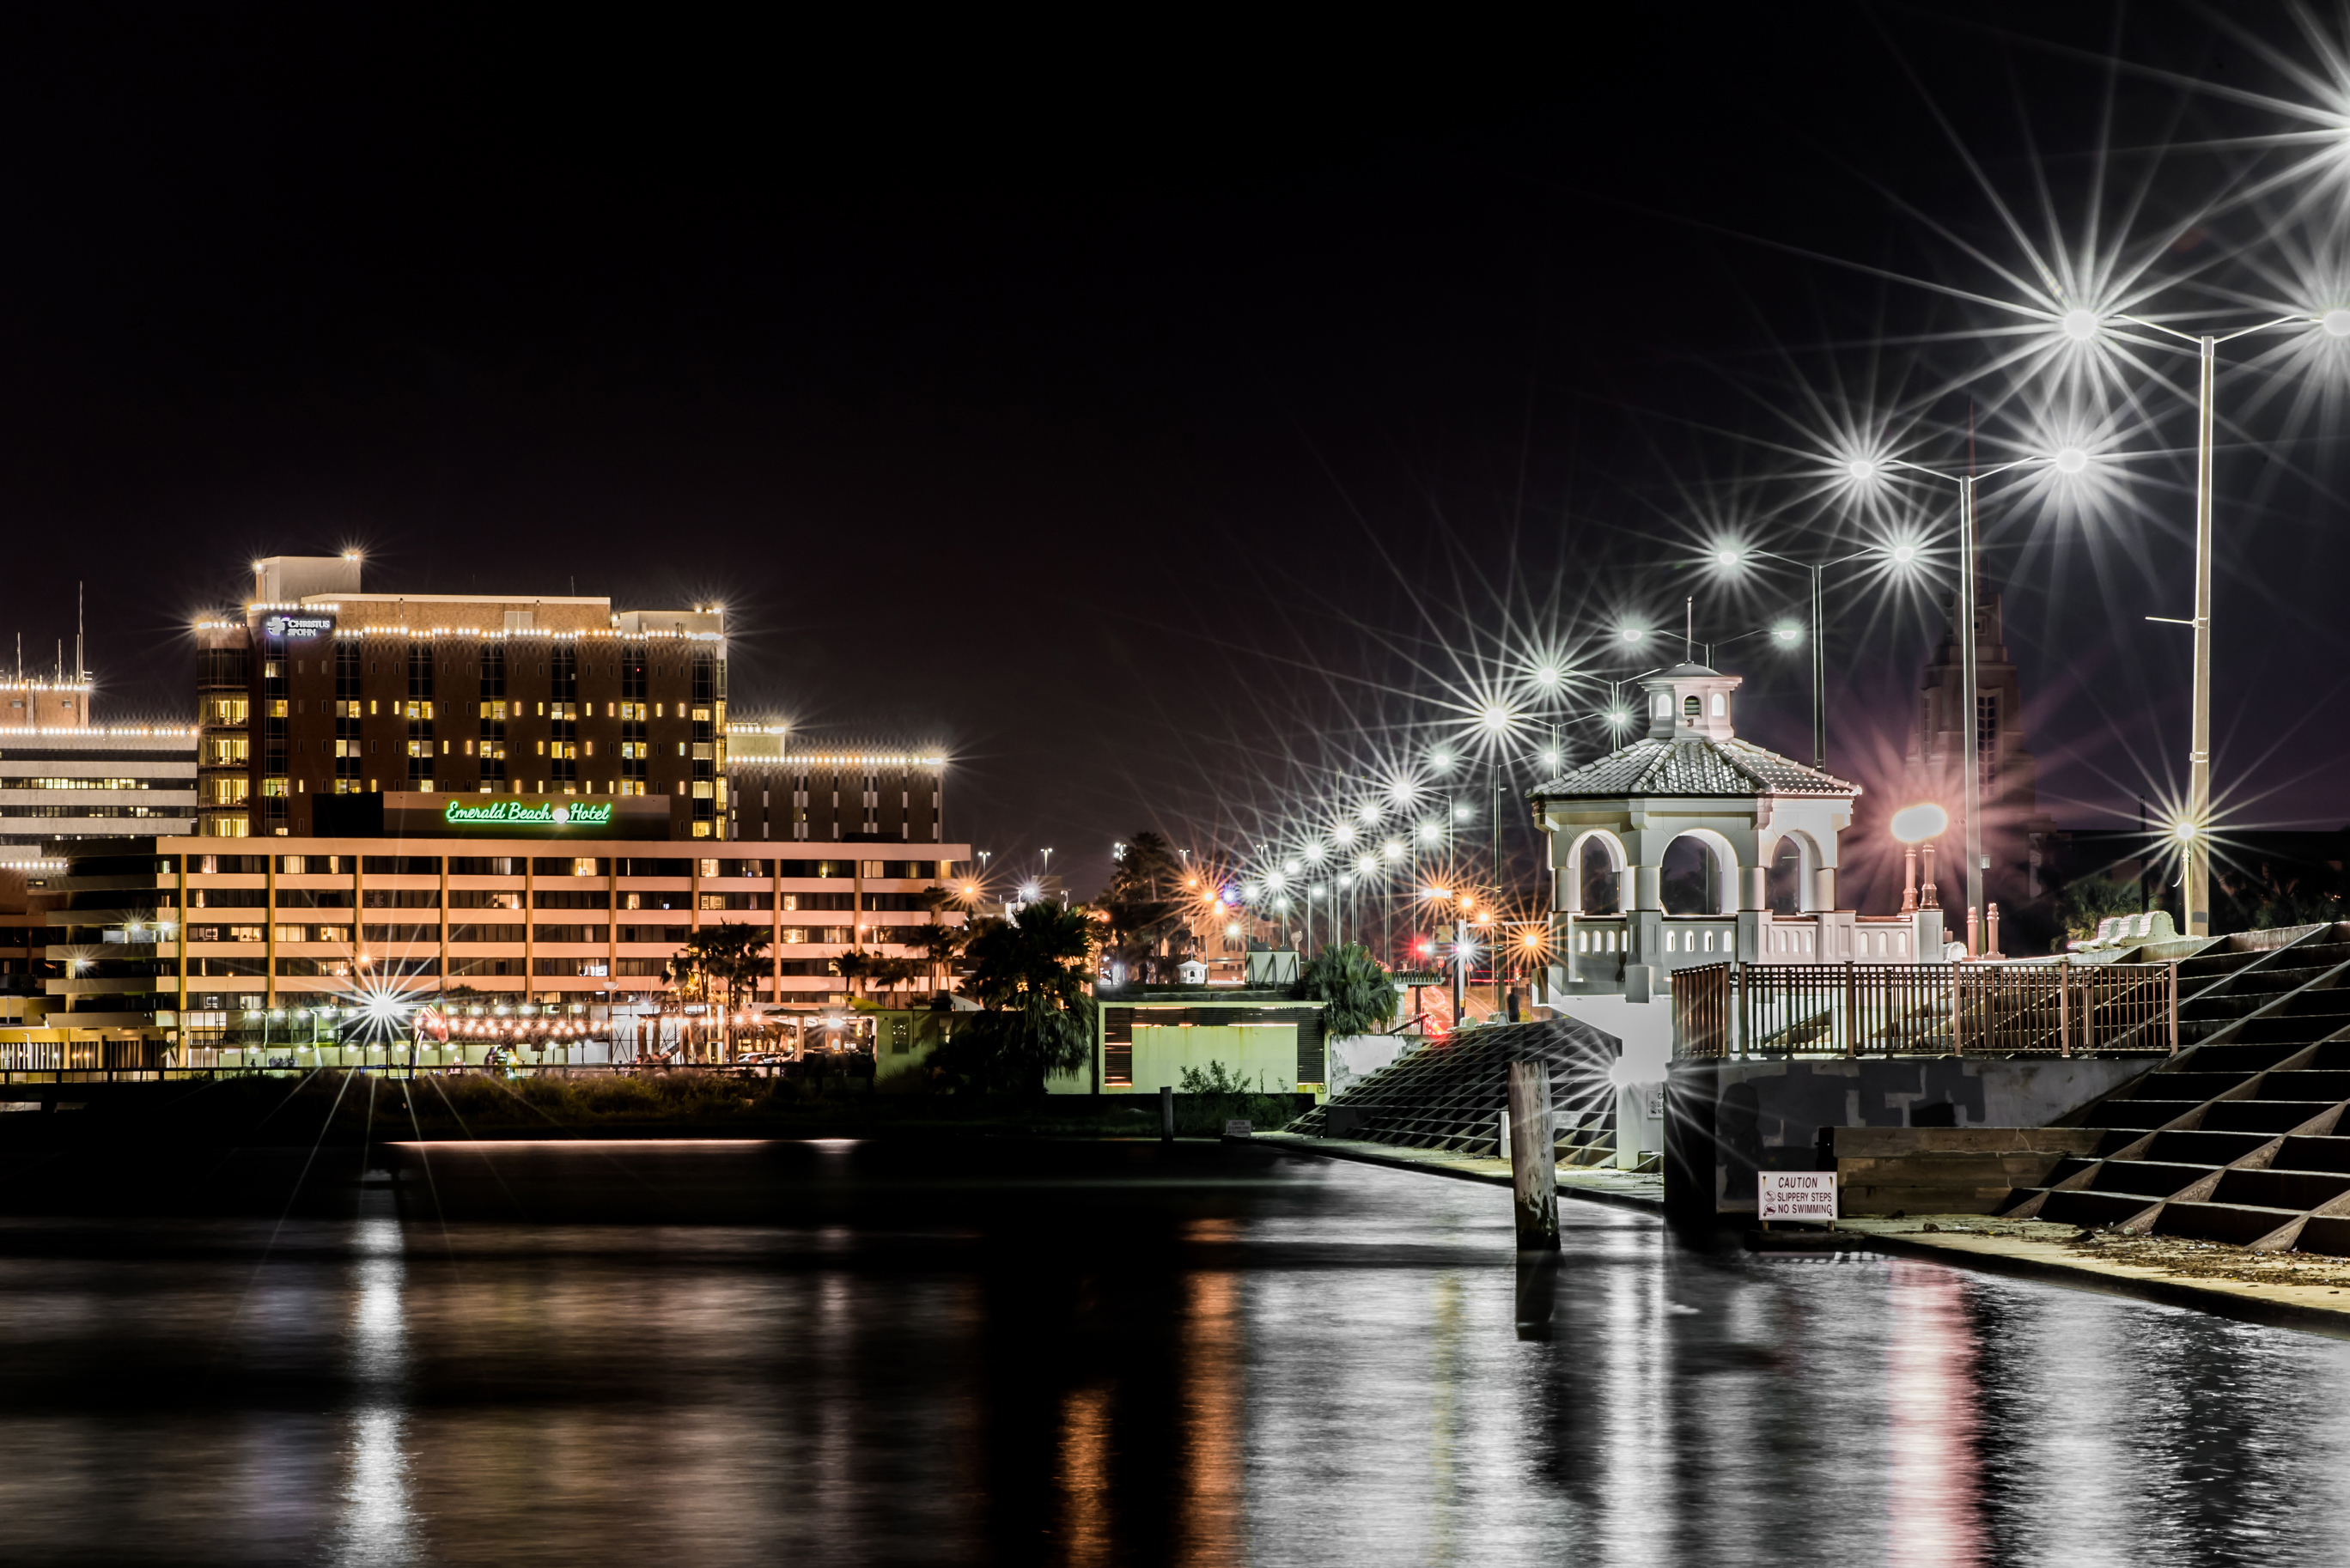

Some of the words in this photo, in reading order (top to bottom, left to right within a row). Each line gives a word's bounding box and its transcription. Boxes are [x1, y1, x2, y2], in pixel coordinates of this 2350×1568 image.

[447, 801, 505, 820] Emerald
[508, 802, 552, 820] Beach
[570, 802, 612, 820] Hotel
[1778, 1176, 1818, 1188] CAUTION
[1777, 1192, 1809, 1202] SLIPPERY
[1811, 1192, 1832, 1202] STEPS
[1778, 1204, 1789, 1214] NO
[1792, 1204, 1832, 1214] SWIMMING
